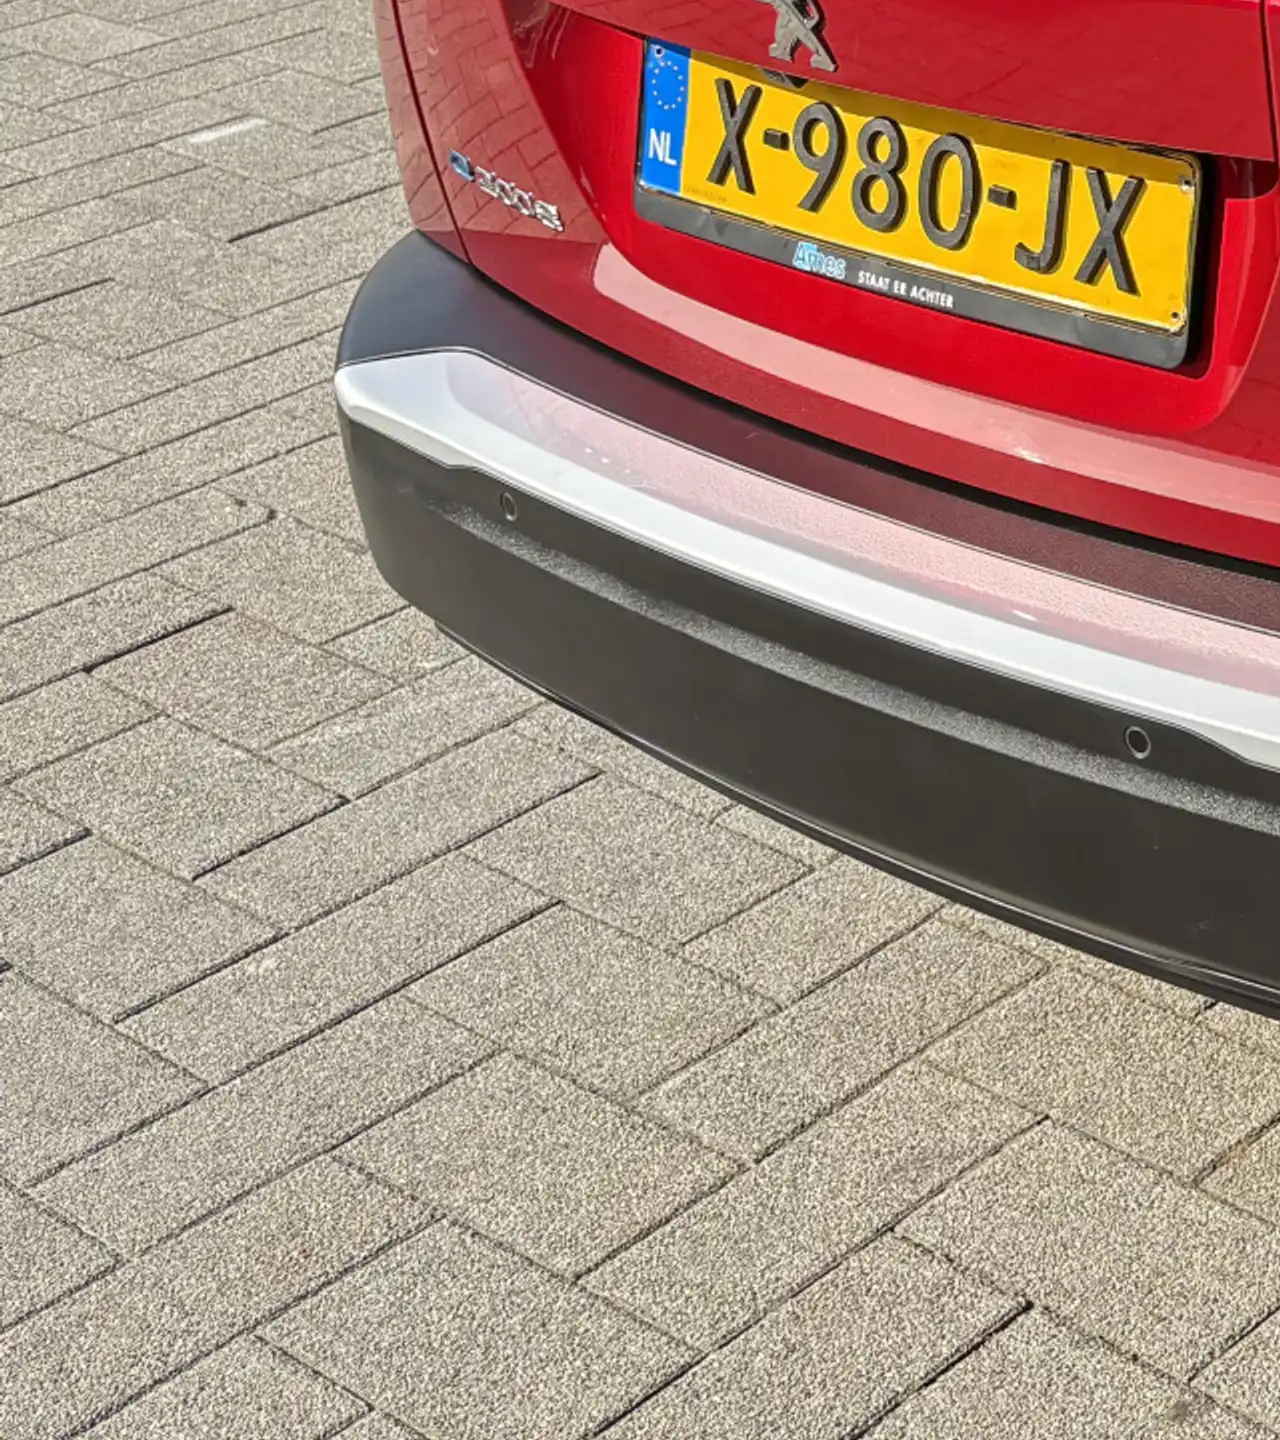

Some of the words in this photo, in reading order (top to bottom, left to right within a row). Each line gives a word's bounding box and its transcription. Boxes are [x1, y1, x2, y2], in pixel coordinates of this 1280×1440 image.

[648, 127, 677, 165] NL
[707, 78, 1146, 296] X-980-JX
[858, 270, 890, 293] STAAT
[910, 286, 954, 309] ACHTER
